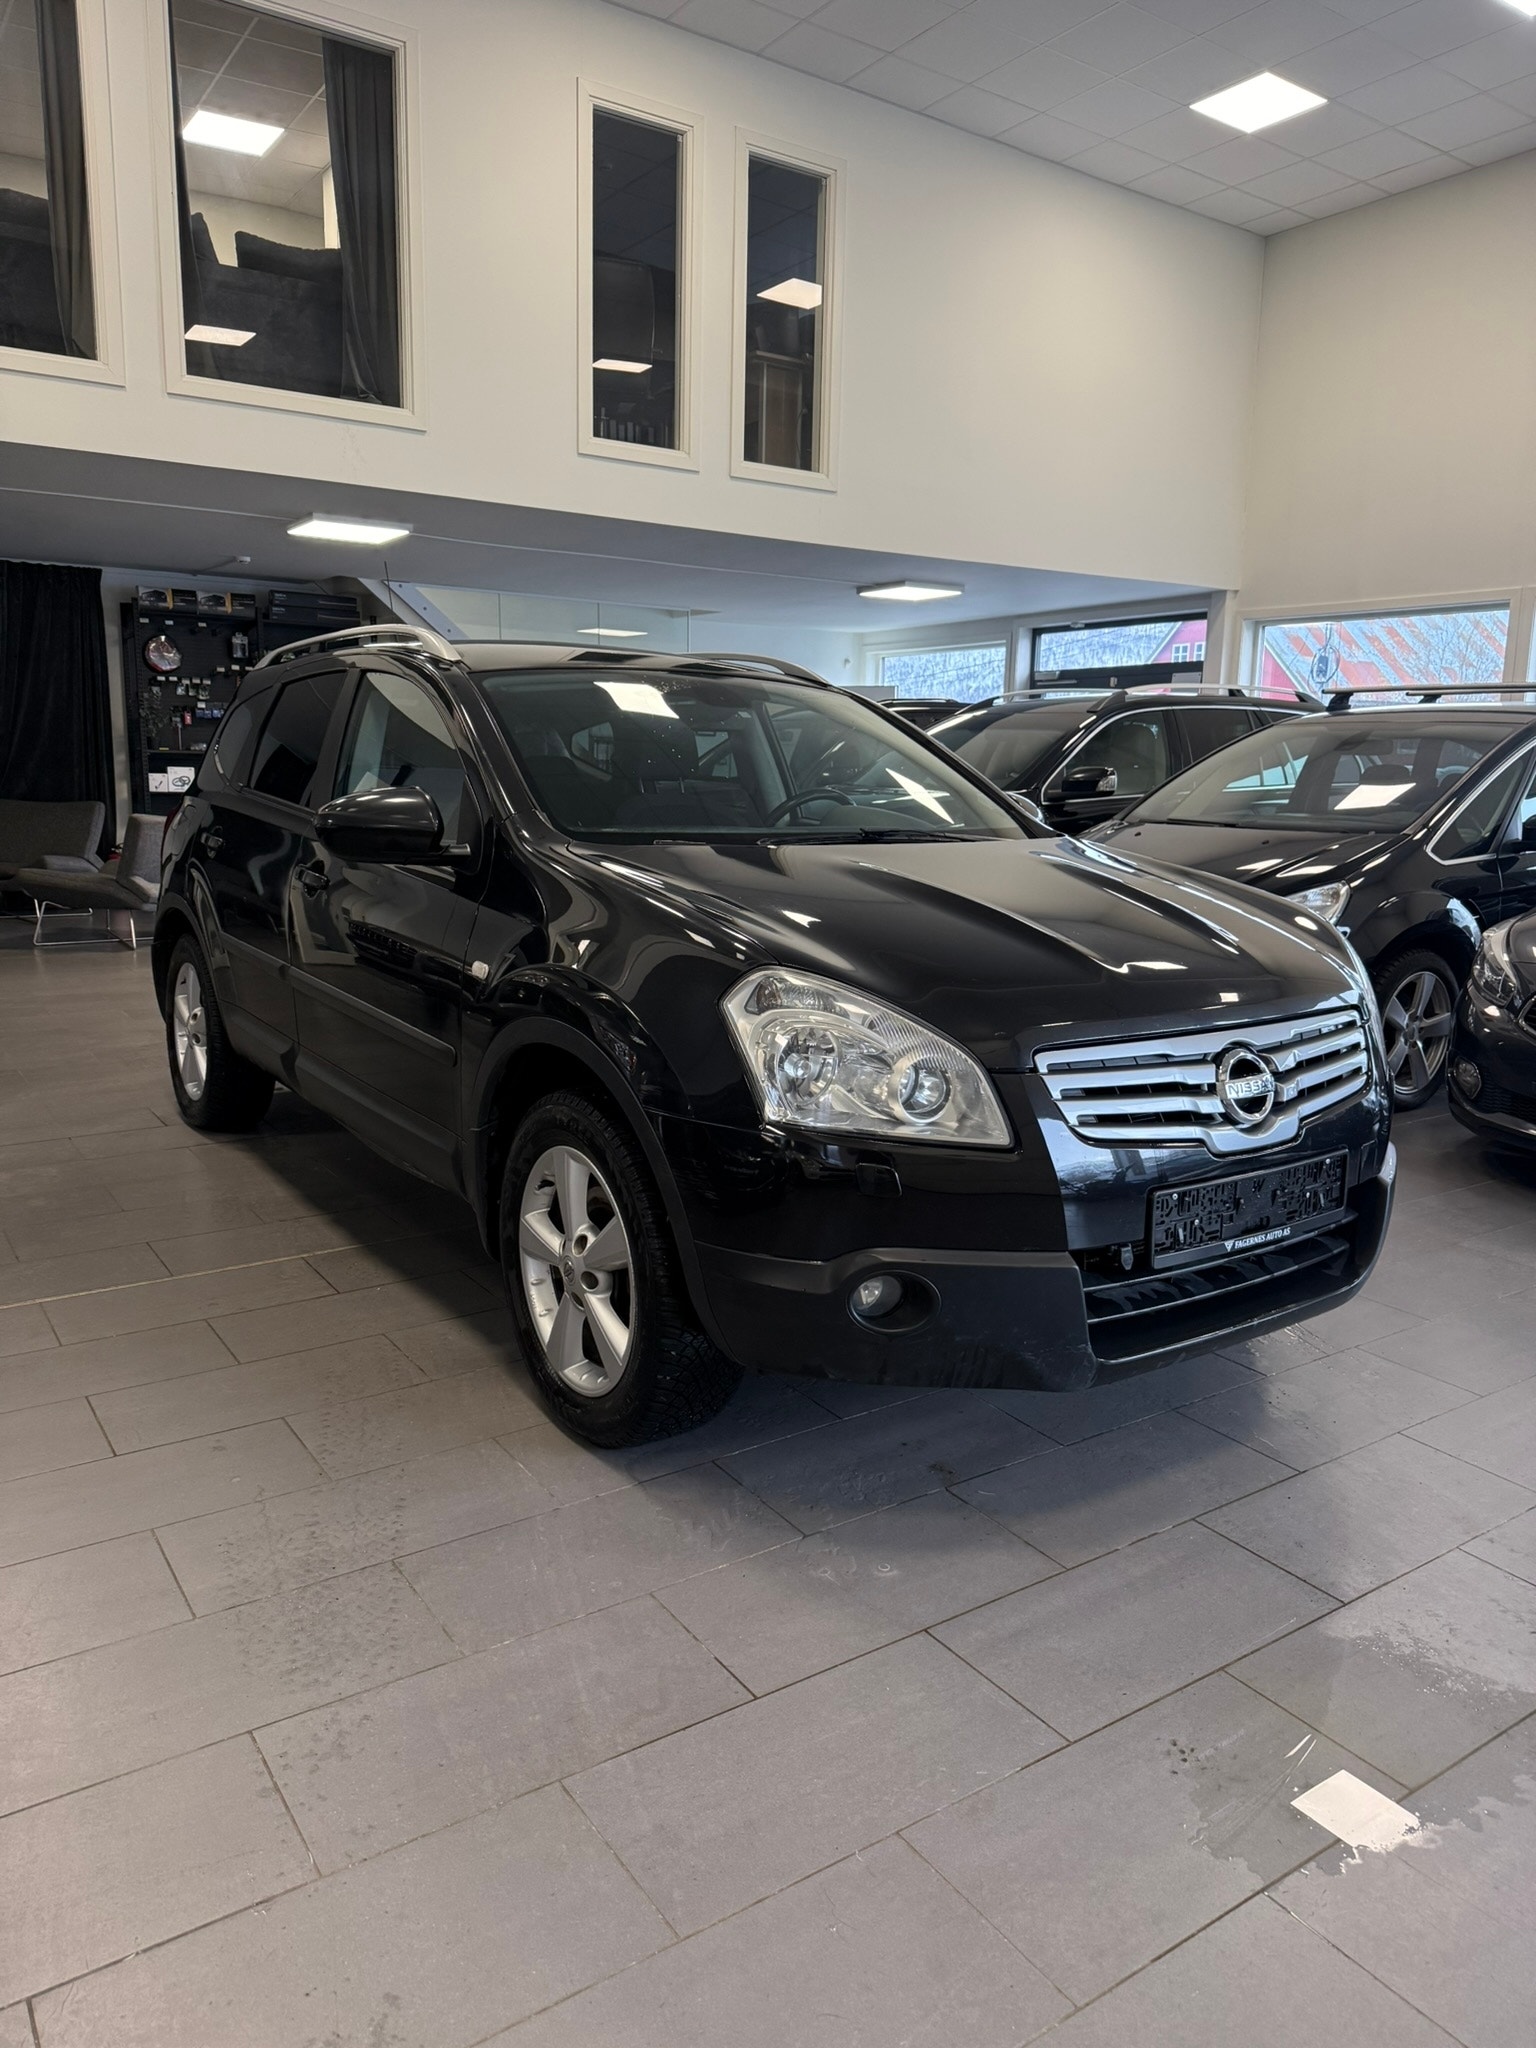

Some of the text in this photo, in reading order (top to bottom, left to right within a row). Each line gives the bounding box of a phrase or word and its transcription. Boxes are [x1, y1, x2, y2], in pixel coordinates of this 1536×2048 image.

[1234, 1227, 1291, 1249] FAGERNES AUTO AS
